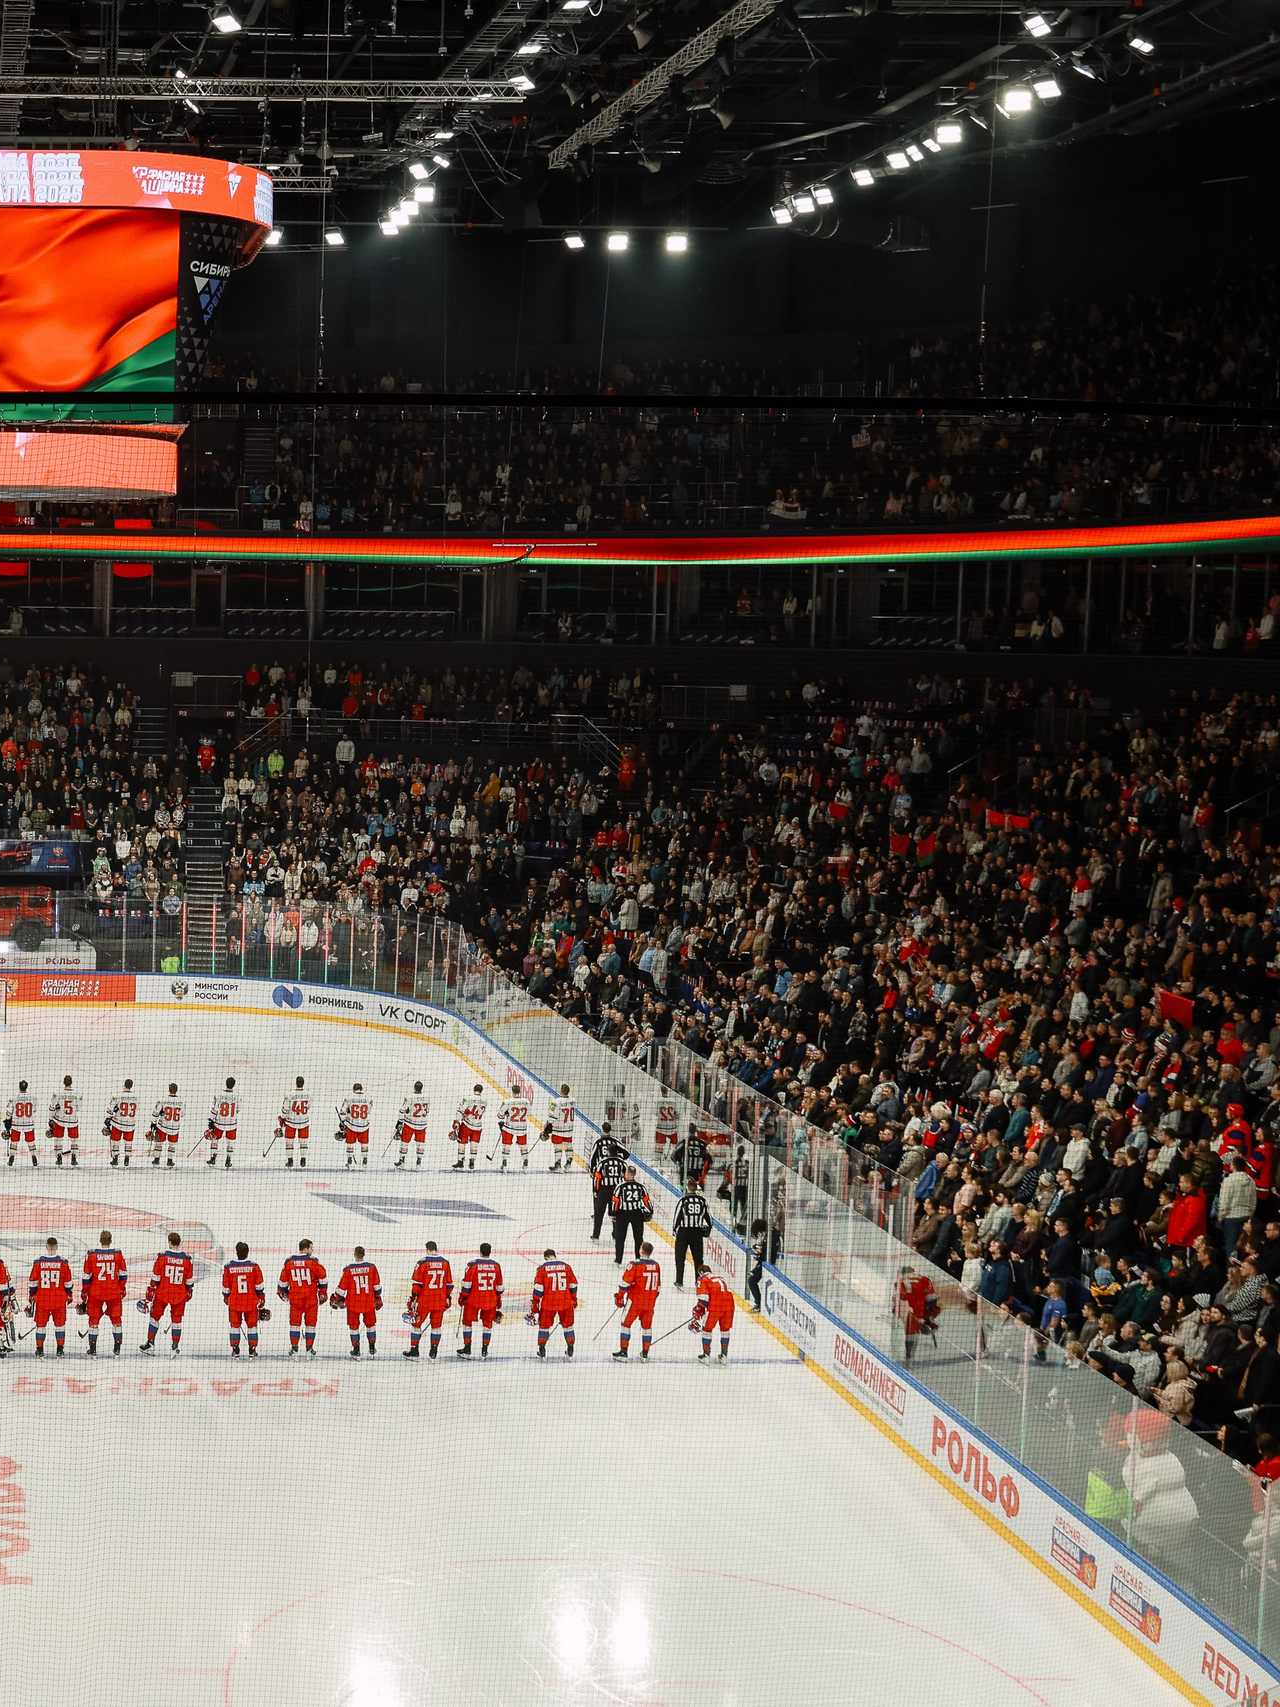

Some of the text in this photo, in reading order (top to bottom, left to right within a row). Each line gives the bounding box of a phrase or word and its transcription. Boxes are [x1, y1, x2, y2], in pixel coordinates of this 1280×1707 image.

[34, 184, 84, 203] 2025
[40, 987, 79, 996] МАШИНА
[41, 979, 80, 987] КРАСНАЯ
[194, 982, 239, 992] МИНСПОРТ
[194, 992, 229, 1001] РОССИИ
[308, 995, 364, 1011] НОРНИКЕЛЬ
[379, 1003, 447, 1033] VK СПОРТ
[15, 1101, 33, 1118] 80
[64, 1100, 74, 1115] 5
[120, 1101, 137, 1118] 93
[220, 1101, 236, 1118] 81
[291, 1100, 309, 1116] 46
[350, 1104, 369, 1119] 68
[412, 1102, 429, 1119] 23
[510, 1106, 528, 1122] 22
[562, 1107, 576, 1123] 70
[608, 1166, 619, 1177] 31
[626, 1190, 639, 1201] 24
[88, 1206, 147, 1220] CUP
[688, 1203, 701, 1214] 98
[40, 1270, 61, 1289] 89
[96, 1262, 115, 1281] 24
[164, 1264, 185, 1285] 96
[290, 1268, 312, 1287] 44
[427, 1270, 446, 1289] 27
[237, 1274, 248, 1294] 6
[353, 1275, 370, 1295] 14
[477, 1272, 496, 1291] 53
[546, 1272, 567, 1291] 76
[642, 1272, 659, 1291] 70
[12, 1375, 342, 1398] КРАСНАЯ
[931, 1414, 1021, 1519] РОЛЬФ
[1055, 1515, 1082, 1541] КРАСНАЯ
[1115, 1562, 1143, 1593] КРАСНАЯ
